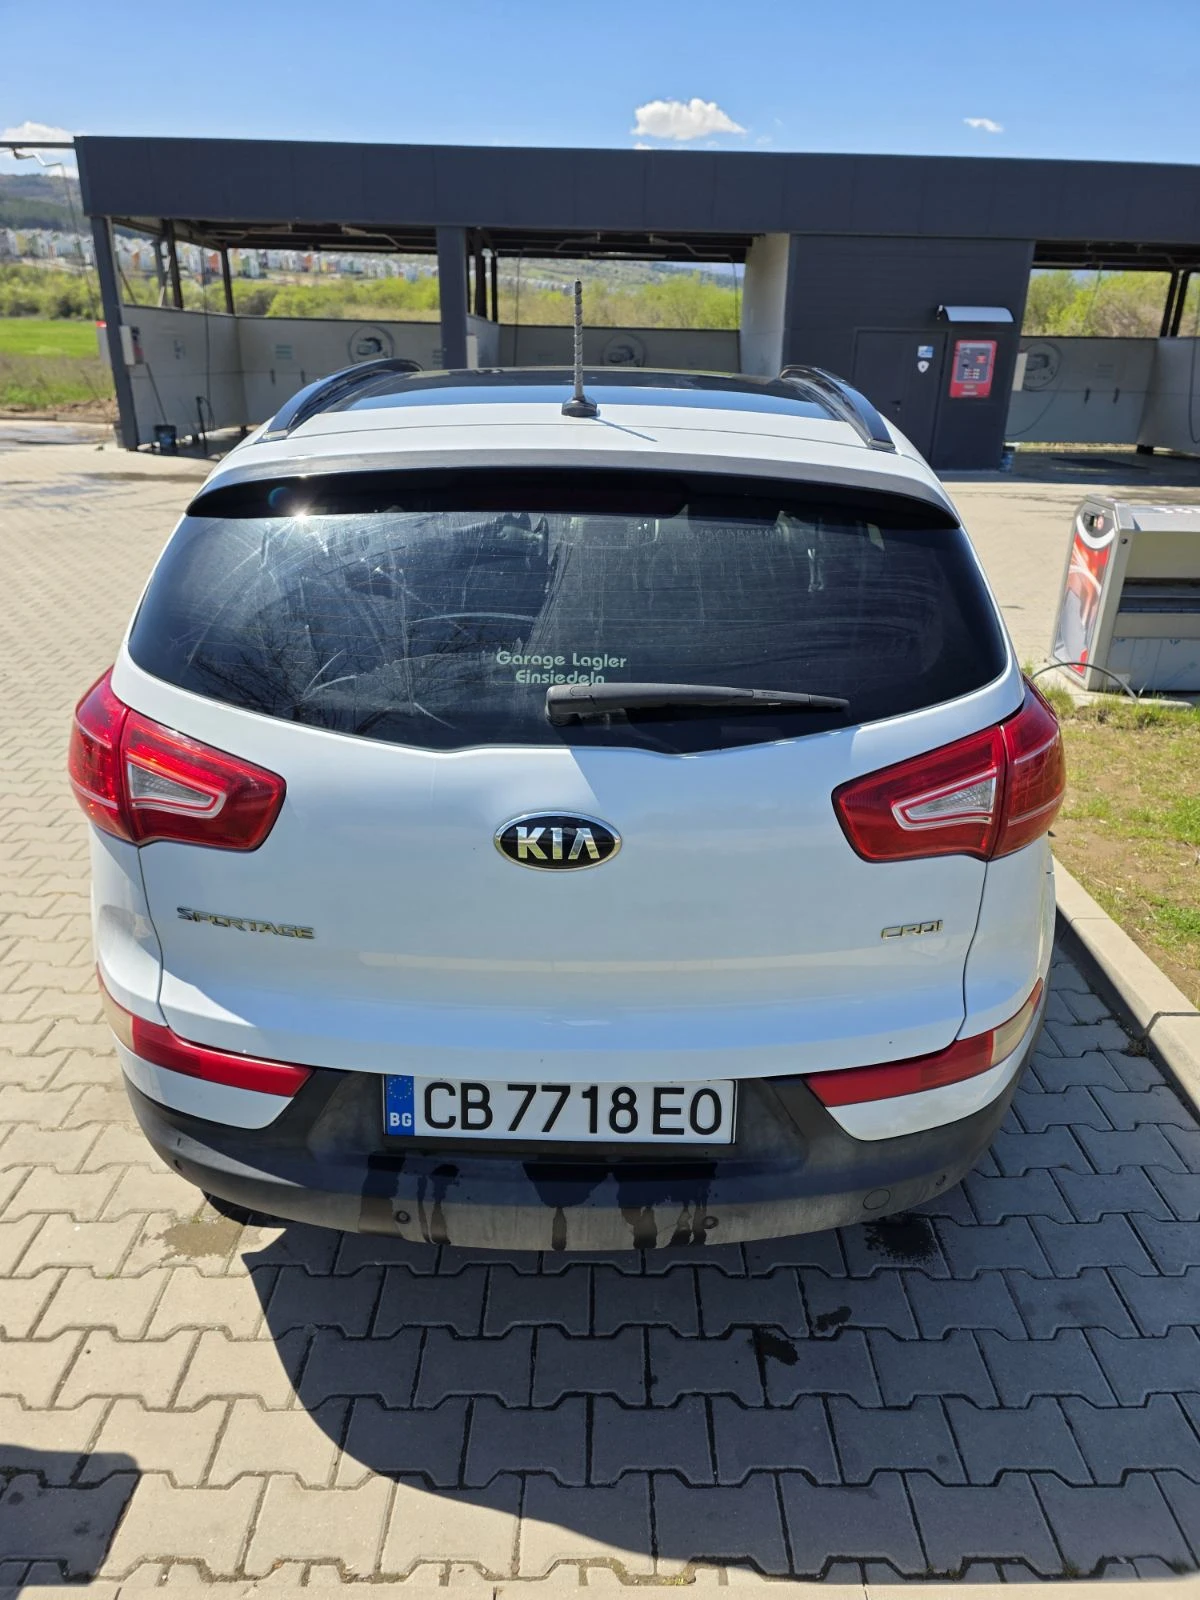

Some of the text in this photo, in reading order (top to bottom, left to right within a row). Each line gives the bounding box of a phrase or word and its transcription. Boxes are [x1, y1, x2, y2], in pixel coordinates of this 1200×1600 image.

[496, 651, 627, 670] Garage Lagler
[515, 669, 605, 684] Einsiedeln
[516, 826, 600, 860] KIA
[176, 906, 315, 939] SPORTAGE
[389, 1112, 412, 1127] BG
